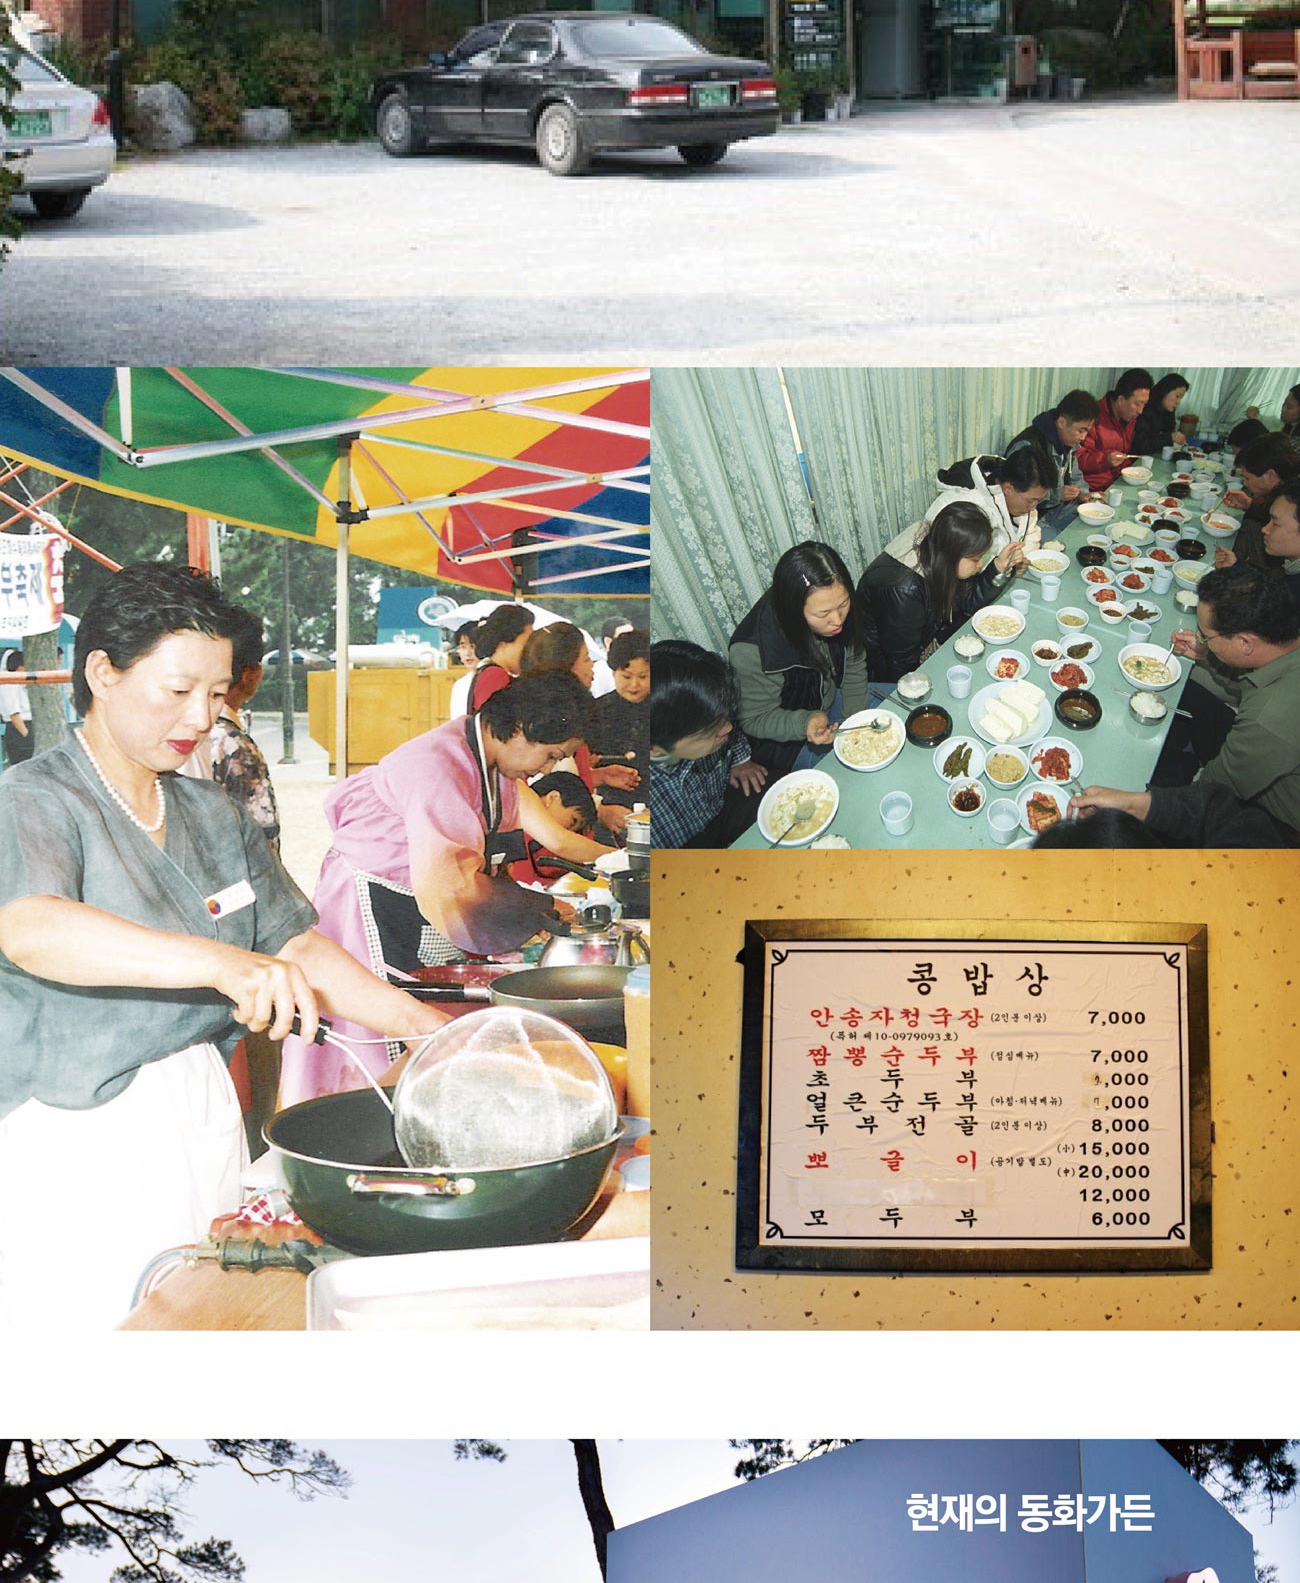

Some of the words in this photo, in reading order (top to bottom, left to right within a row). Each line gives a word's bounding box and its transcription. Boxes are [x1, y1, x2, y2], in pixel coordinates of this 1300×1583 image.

[1088, 1011, 1146, 1026] 7,000
[1091, 1050, 1149, 1065] 7,000
[1092, 1119, 1150, 1134] 8,000
[1079, 1142, 1150, 1157] 15,000
[1079, 1165, 1150, 1180] 20,000
[1079, 1188, 1150, 1204] 12,000
[1092, 1212, 1150, 1227] 6,000
